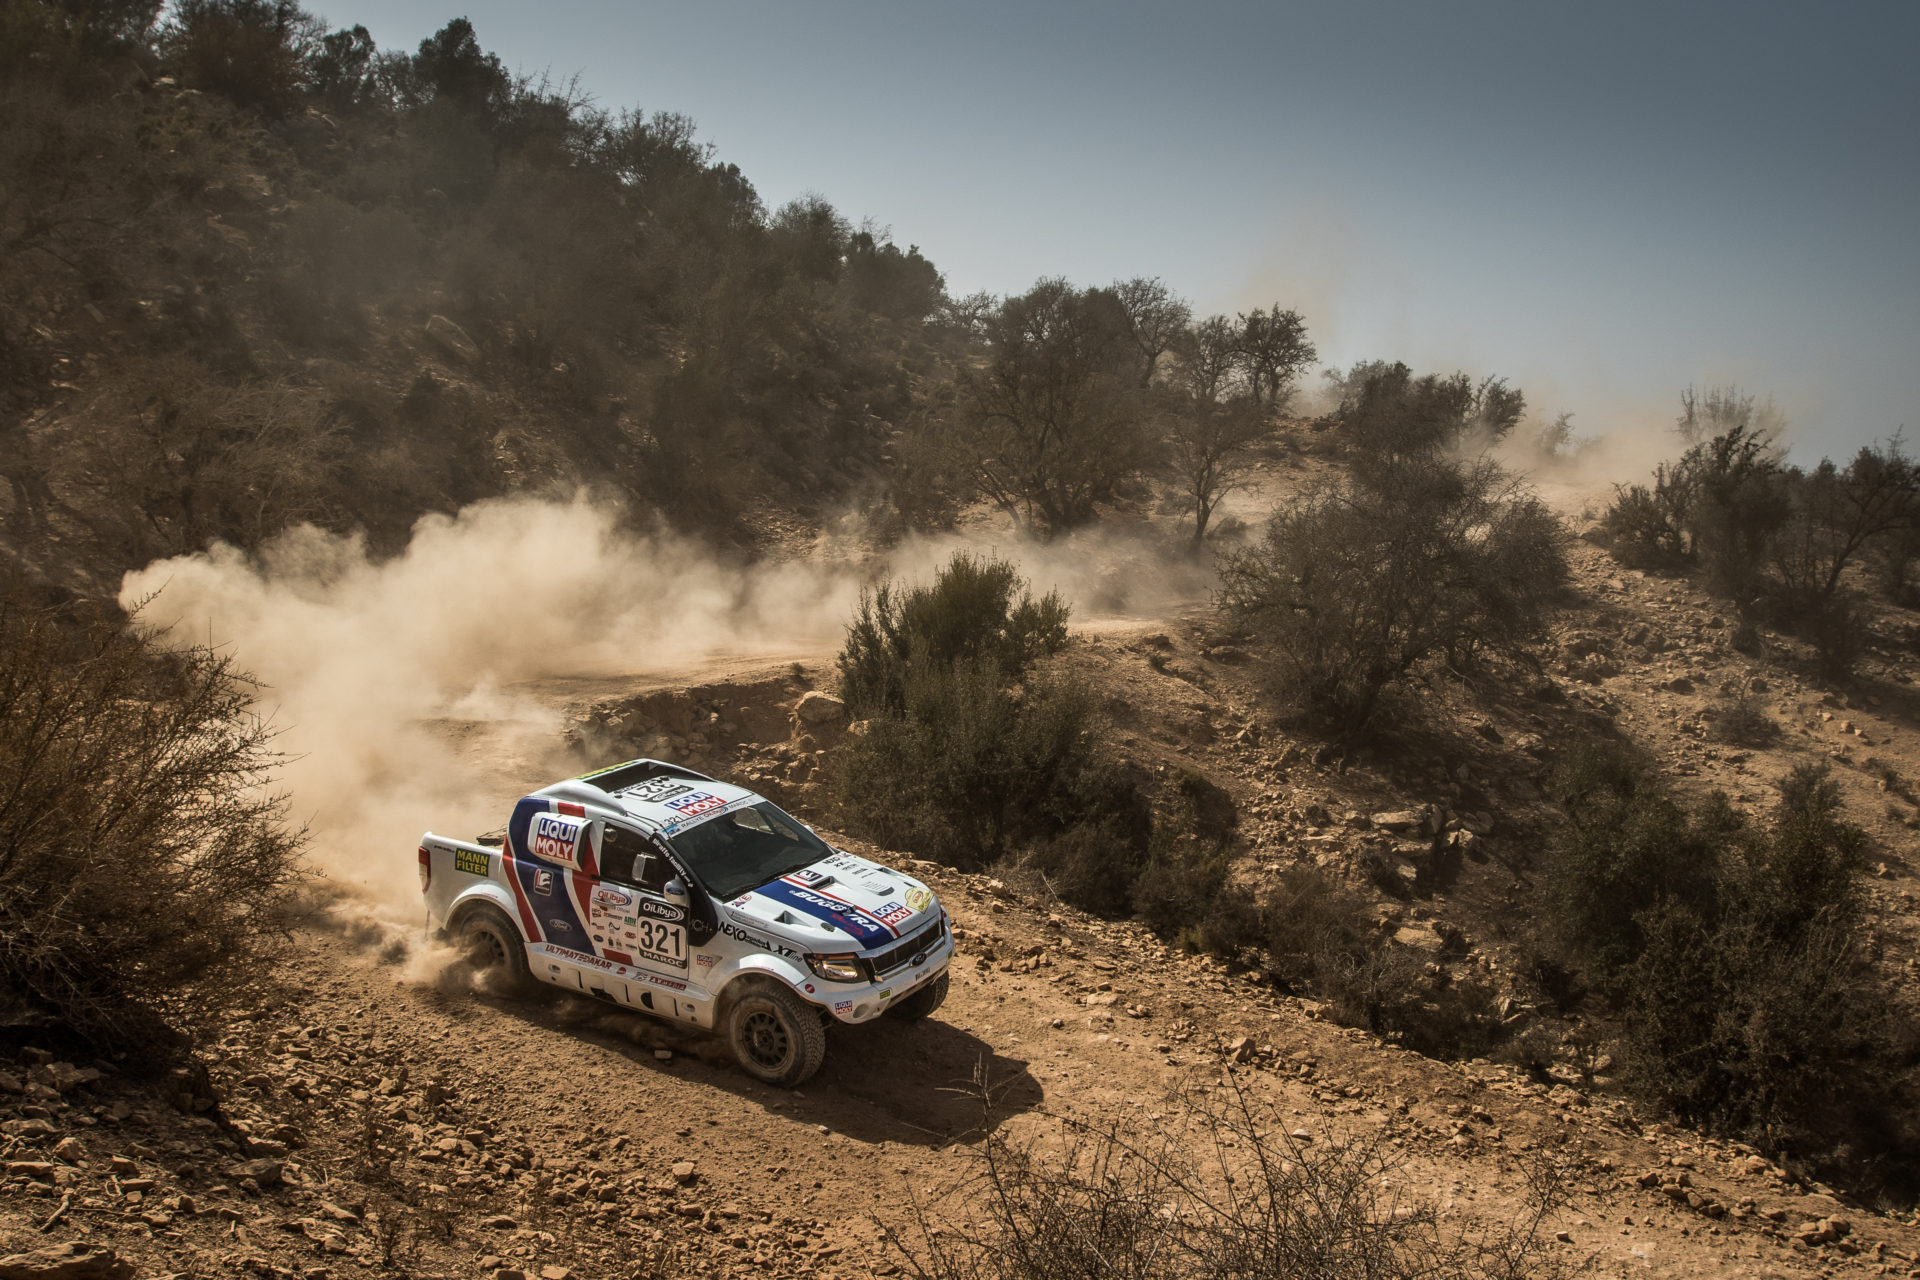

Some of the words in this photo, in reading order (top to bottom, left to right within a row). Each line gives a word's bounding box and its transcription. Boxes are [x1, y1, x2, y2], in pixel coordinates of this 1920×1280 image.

[667, 791, 713, 809] LIQUI
[680, 796, 725, 816] MOLY
[663, 815, 684, 826] 321
[681, 815, 704, 828] RALLYE
[539, 818, 577, 842] LIQUI
[536, 836, 573, 860] MOLY
[457, 850, 488, 865] MANN
[456, 860, 488, 875] FILTER
[643, 903, 677, 918] OiLibya
[873, 902, 901, 918] LIQUI
[884, 907, 912, 925] MOLY
[640, 920, 681, 957] 321
[718, 921, 747, 941] NEXO
[643, 951, 684, 968] MAROC
[835, 1000, 853, 1009] LIQUI
[836, 1006, 853, 1015] MOLY
